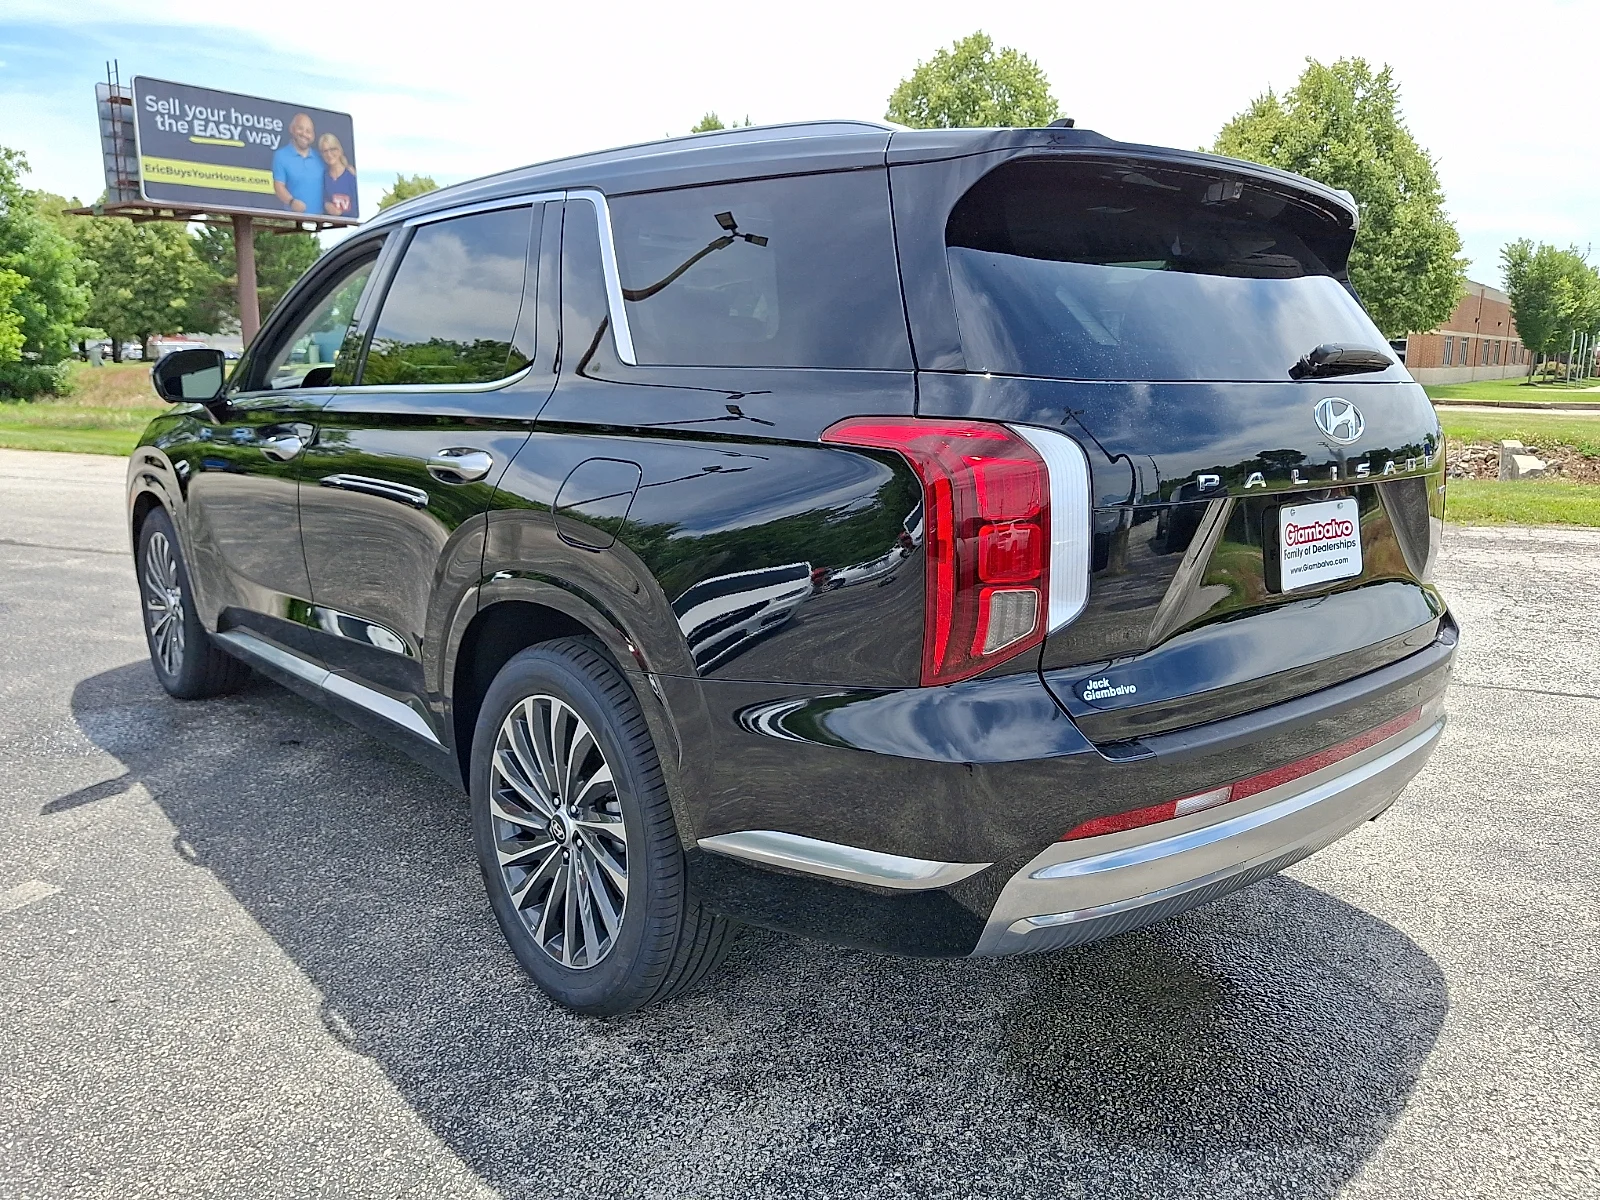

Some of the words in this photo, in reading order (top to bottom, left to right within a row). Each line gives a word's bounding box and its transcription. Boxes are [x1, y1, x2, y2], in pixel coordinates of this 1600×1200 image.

[145, 94, 180, 116] Sell
[184, 103, 226, 122] your
[231, 107, 283, 132] house
[155, 114, 189, 134] the
[193, 119, 242, 141] EASY
[246, 129, 281, 150] way
[145, 164, 270, 185] EricBuysYourHouse.com
[1196, 455, 1433, 491] PALISADE
[1285, 519, 1353, 546] Giambalvo
[1284, 548, 1304, 560] Family
[1312, 539, 1356, 554] Dealerships
[1290, 557, 1348, 574] www.Giambalvo.com
[1083, 684, 1137, 701] Giambalvo
[1086, 677, 1110, 690] Jack
